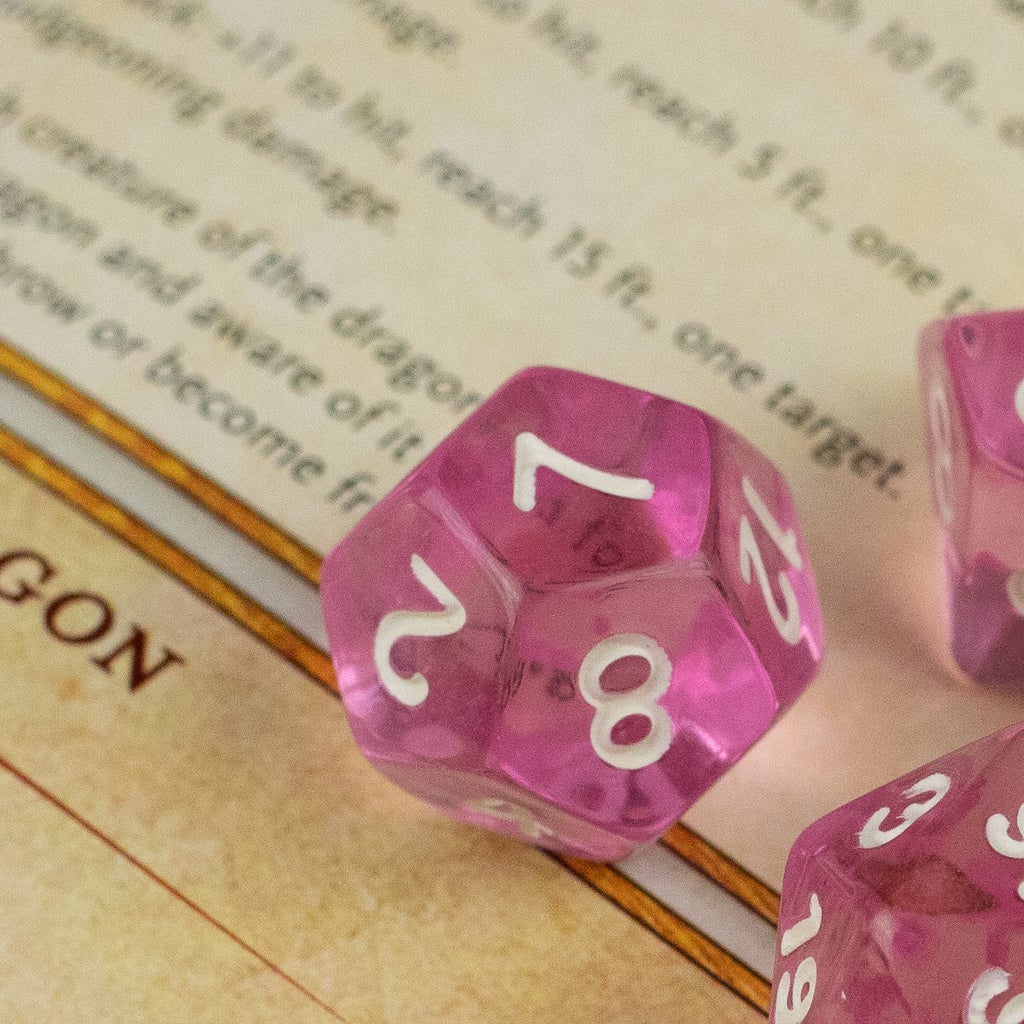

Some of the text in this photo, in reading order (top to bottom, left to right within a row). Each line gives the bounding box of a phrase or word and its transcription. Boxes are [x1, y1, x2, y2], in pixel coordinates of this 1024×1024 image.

[609, 63, 739, 154] reach
[848, 223, 942, 296] one
[98, 243, 202, 306] and
[188, 300, 325, 394] aware
[324, 390, 400, 432] of
[250, 250, 331, 313] the
[420, 147, 544, 238] reach
[550, 225, 611, 279] 15
[671, 320, 765, 392] one
[761, 379, 904, 500] target.
[88, 320, 327, 486] or become
[513, 430, 655, 513] 7
[374, 552, 467, 708] 2
[577, 632, 675, 771] 8
